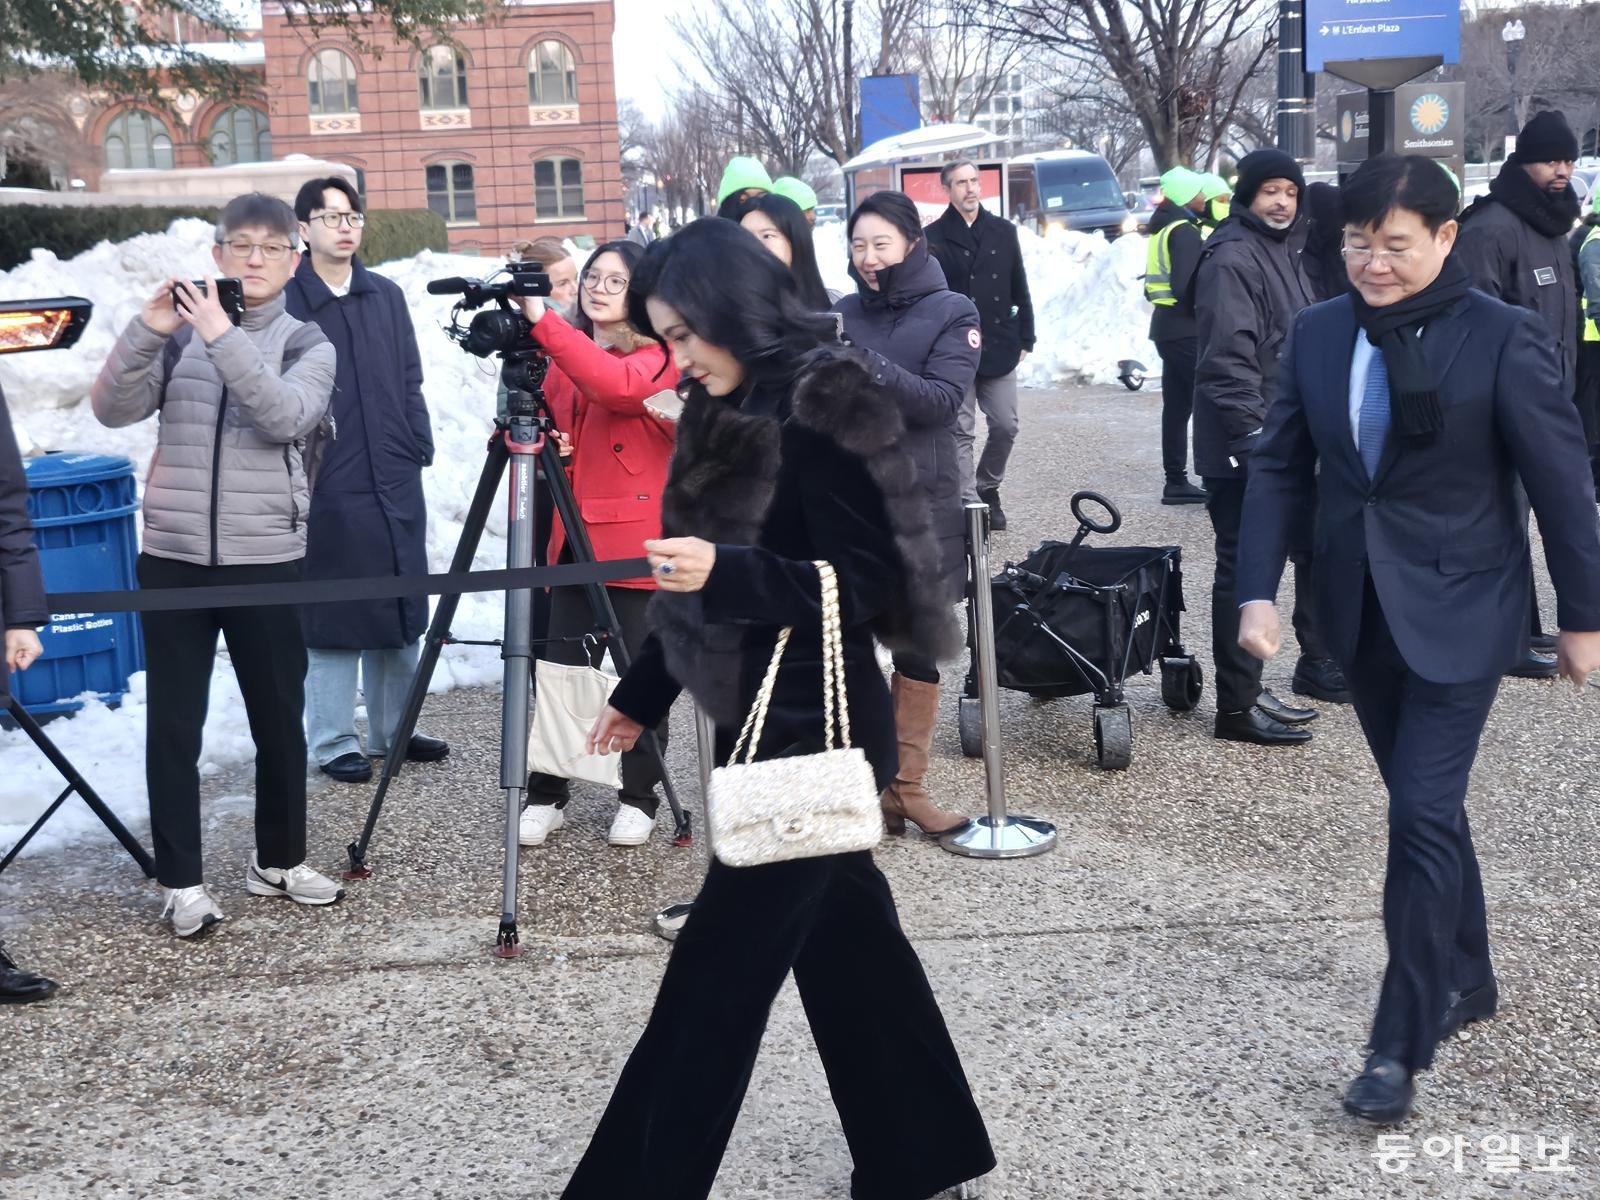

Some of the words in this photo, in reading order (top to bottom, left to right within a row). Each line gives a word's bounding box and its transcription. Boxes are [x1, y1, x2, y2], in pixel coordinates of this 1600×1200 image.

[1342, 24, 1376, 35] L'Enfant
[1377, 23, 1400, 32] Plaza
[1404, 138, 1453, 149] Smithsonian
[52, 623, 84, 633] Plastic
[85, 619, 113, 629] Bottles
